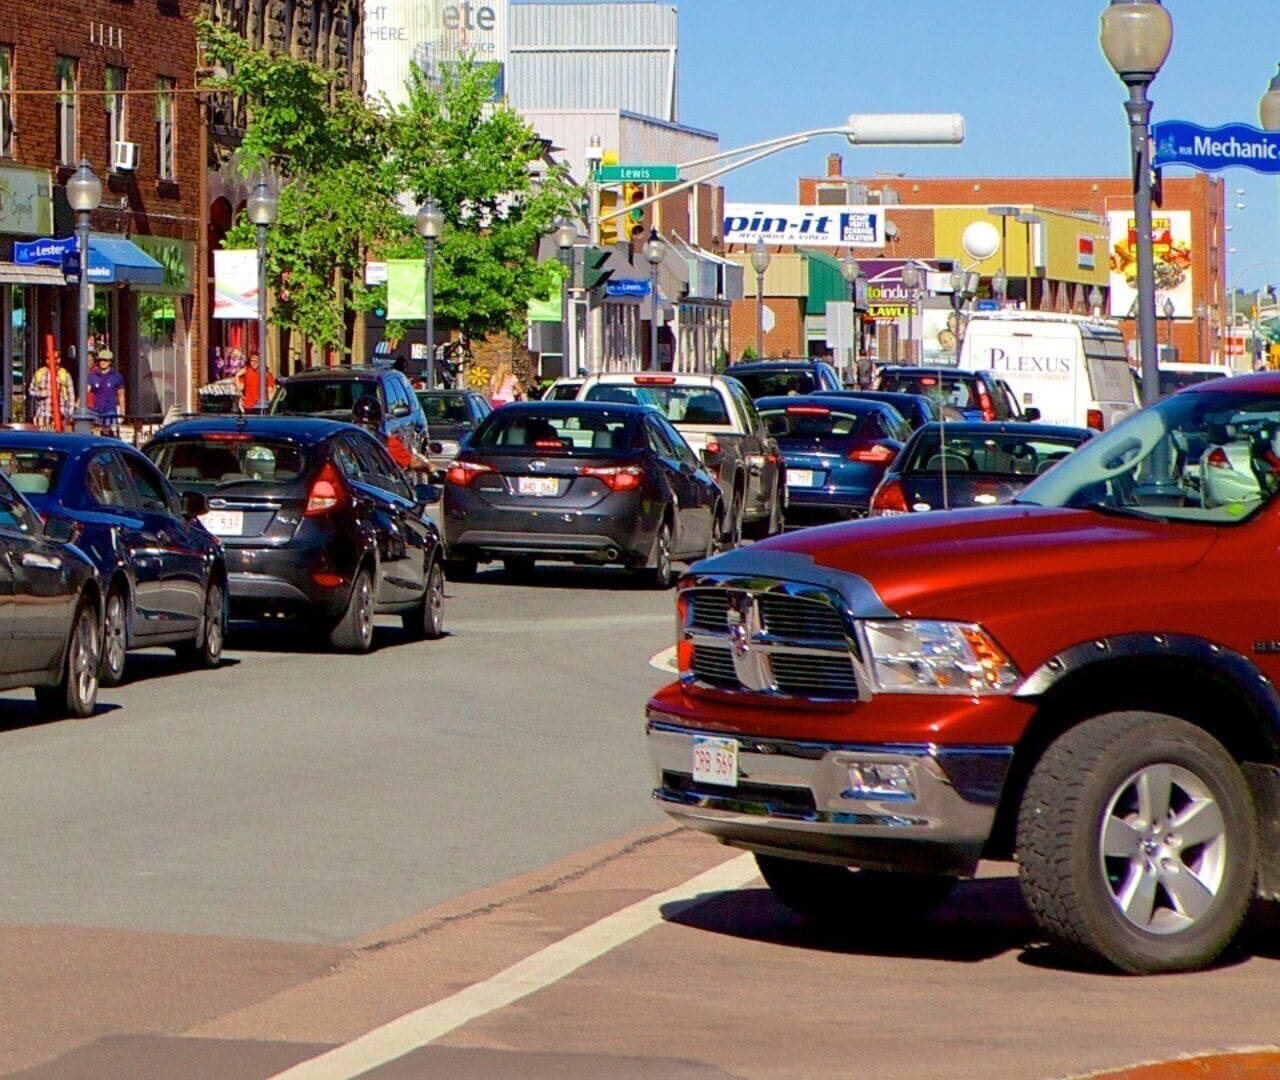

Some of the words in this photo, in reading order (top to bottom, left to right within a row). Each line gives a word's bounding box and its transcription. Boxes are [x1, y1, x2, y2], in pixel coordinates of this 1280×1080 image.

[1194, 135, 1278, 160] Mechanic
[621, 168, 650, 178] Lewis
[724, 211, 833, 236] pin-it
[990, 348, 1070, 372] PLEXUS
